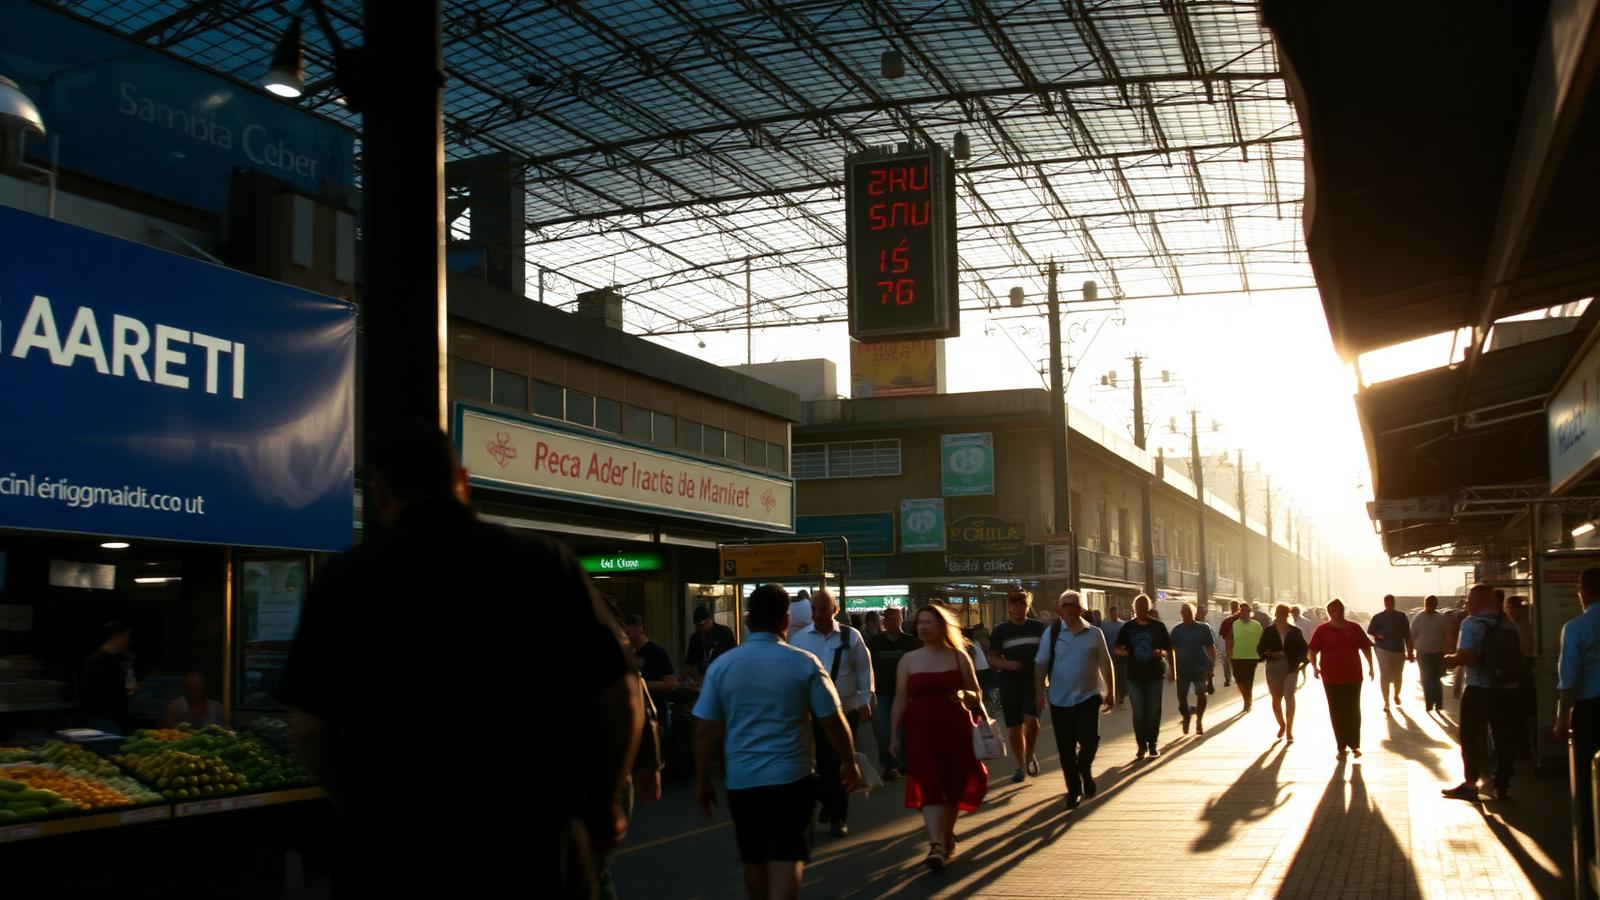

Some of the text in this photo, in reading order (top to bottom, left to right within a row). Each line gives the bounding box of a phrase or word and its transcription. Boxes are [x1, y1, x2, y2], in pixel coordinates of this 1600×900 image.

[0, 295, 245, 399] AARETI
[534, 441, 581, 478] Reca
[586, 453, 628, 487] Ader
